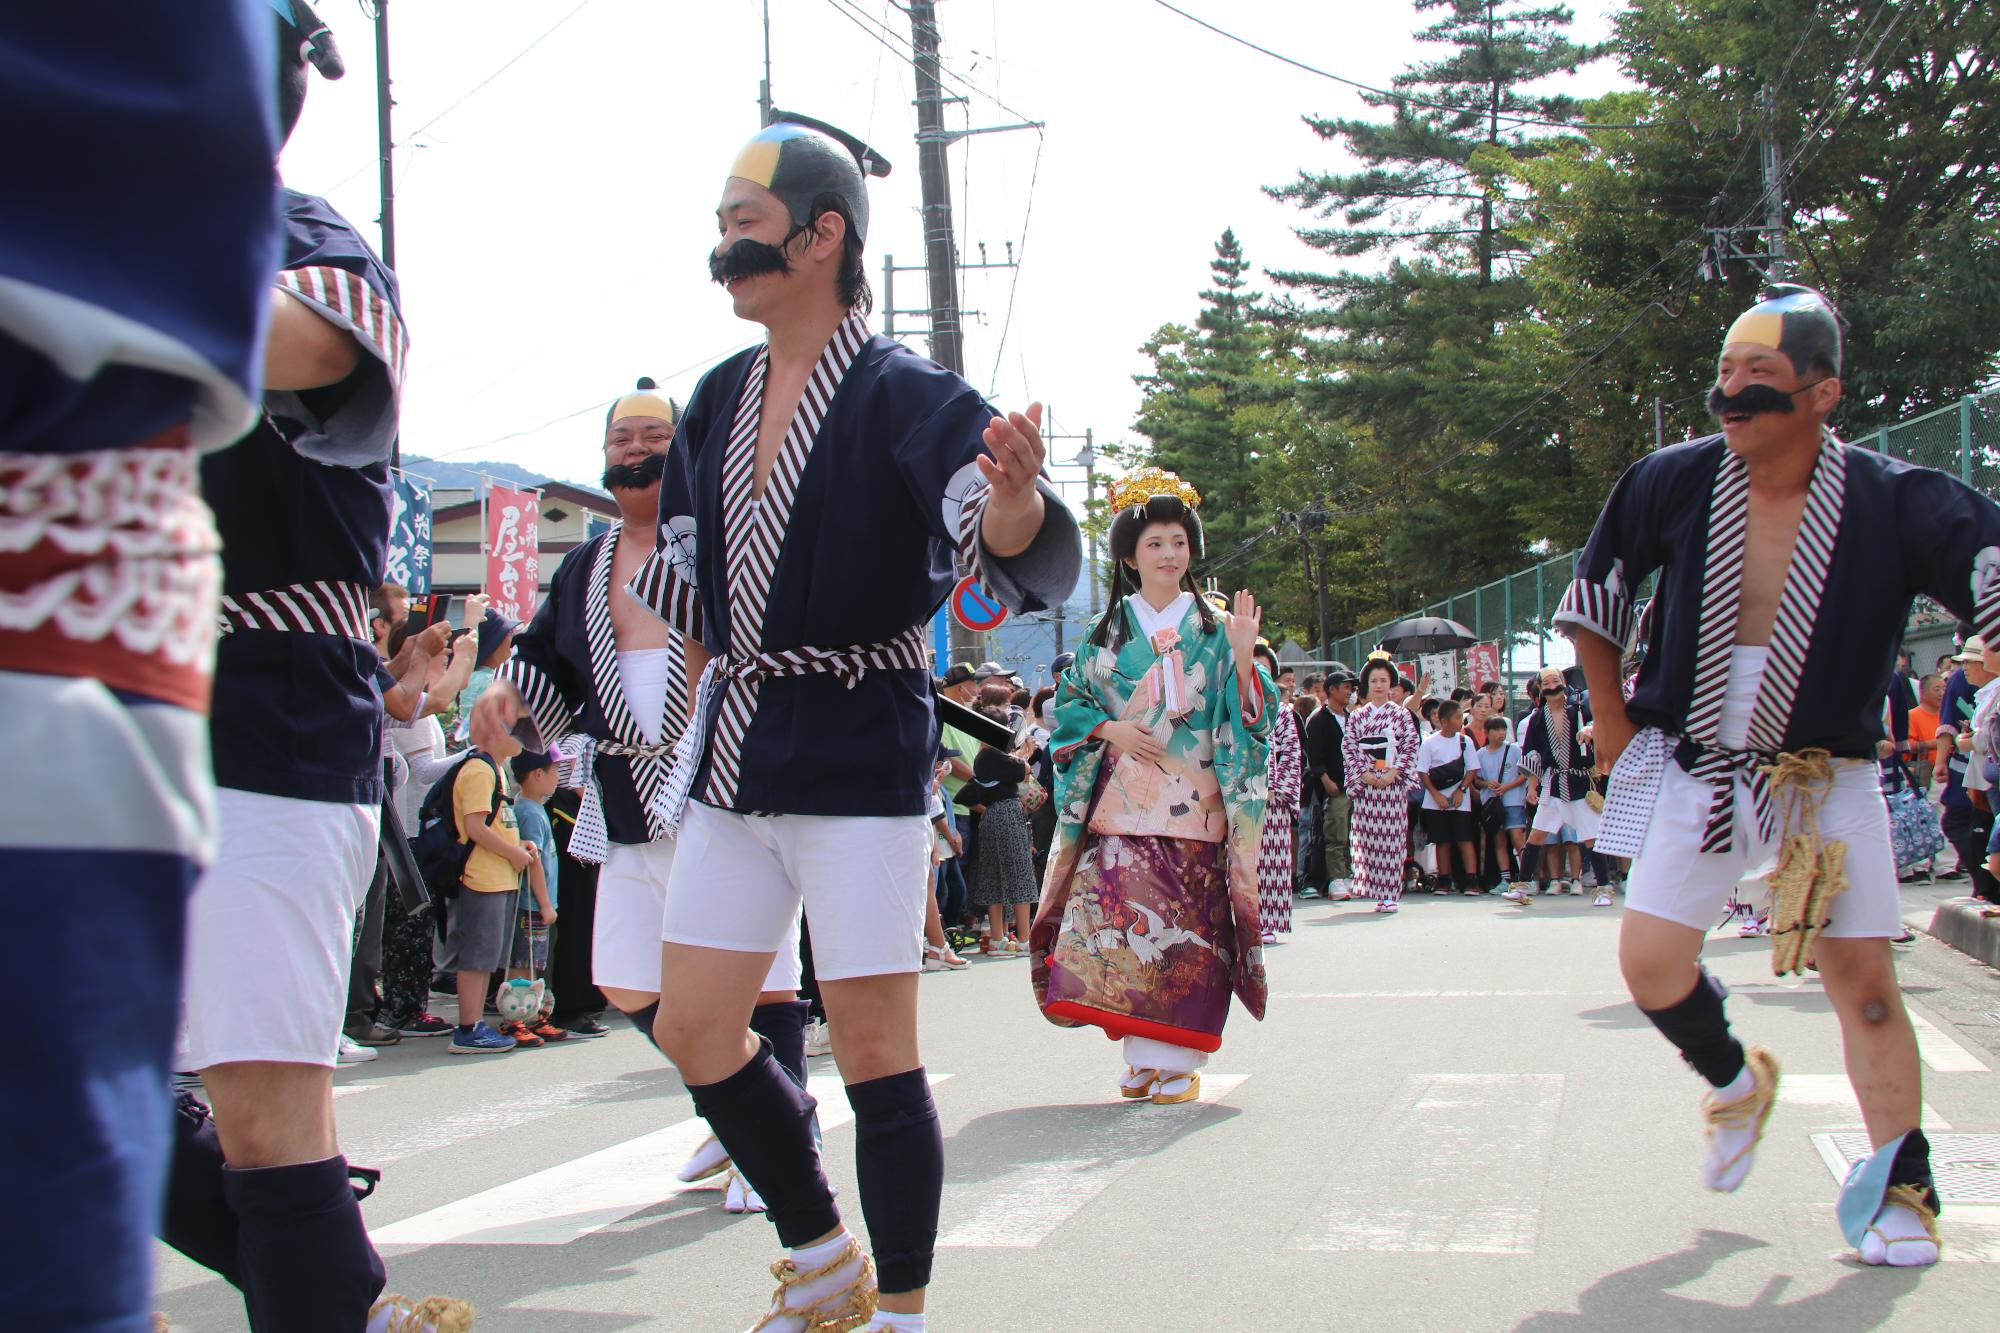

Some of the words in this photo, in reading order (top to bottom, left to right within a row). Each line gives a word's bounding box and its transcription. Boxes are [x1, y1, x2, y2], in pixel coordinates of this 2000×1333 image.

[407, 480, 431, 594] 八朔祭り
[525, 500, 539, 614] 八朔祭り
